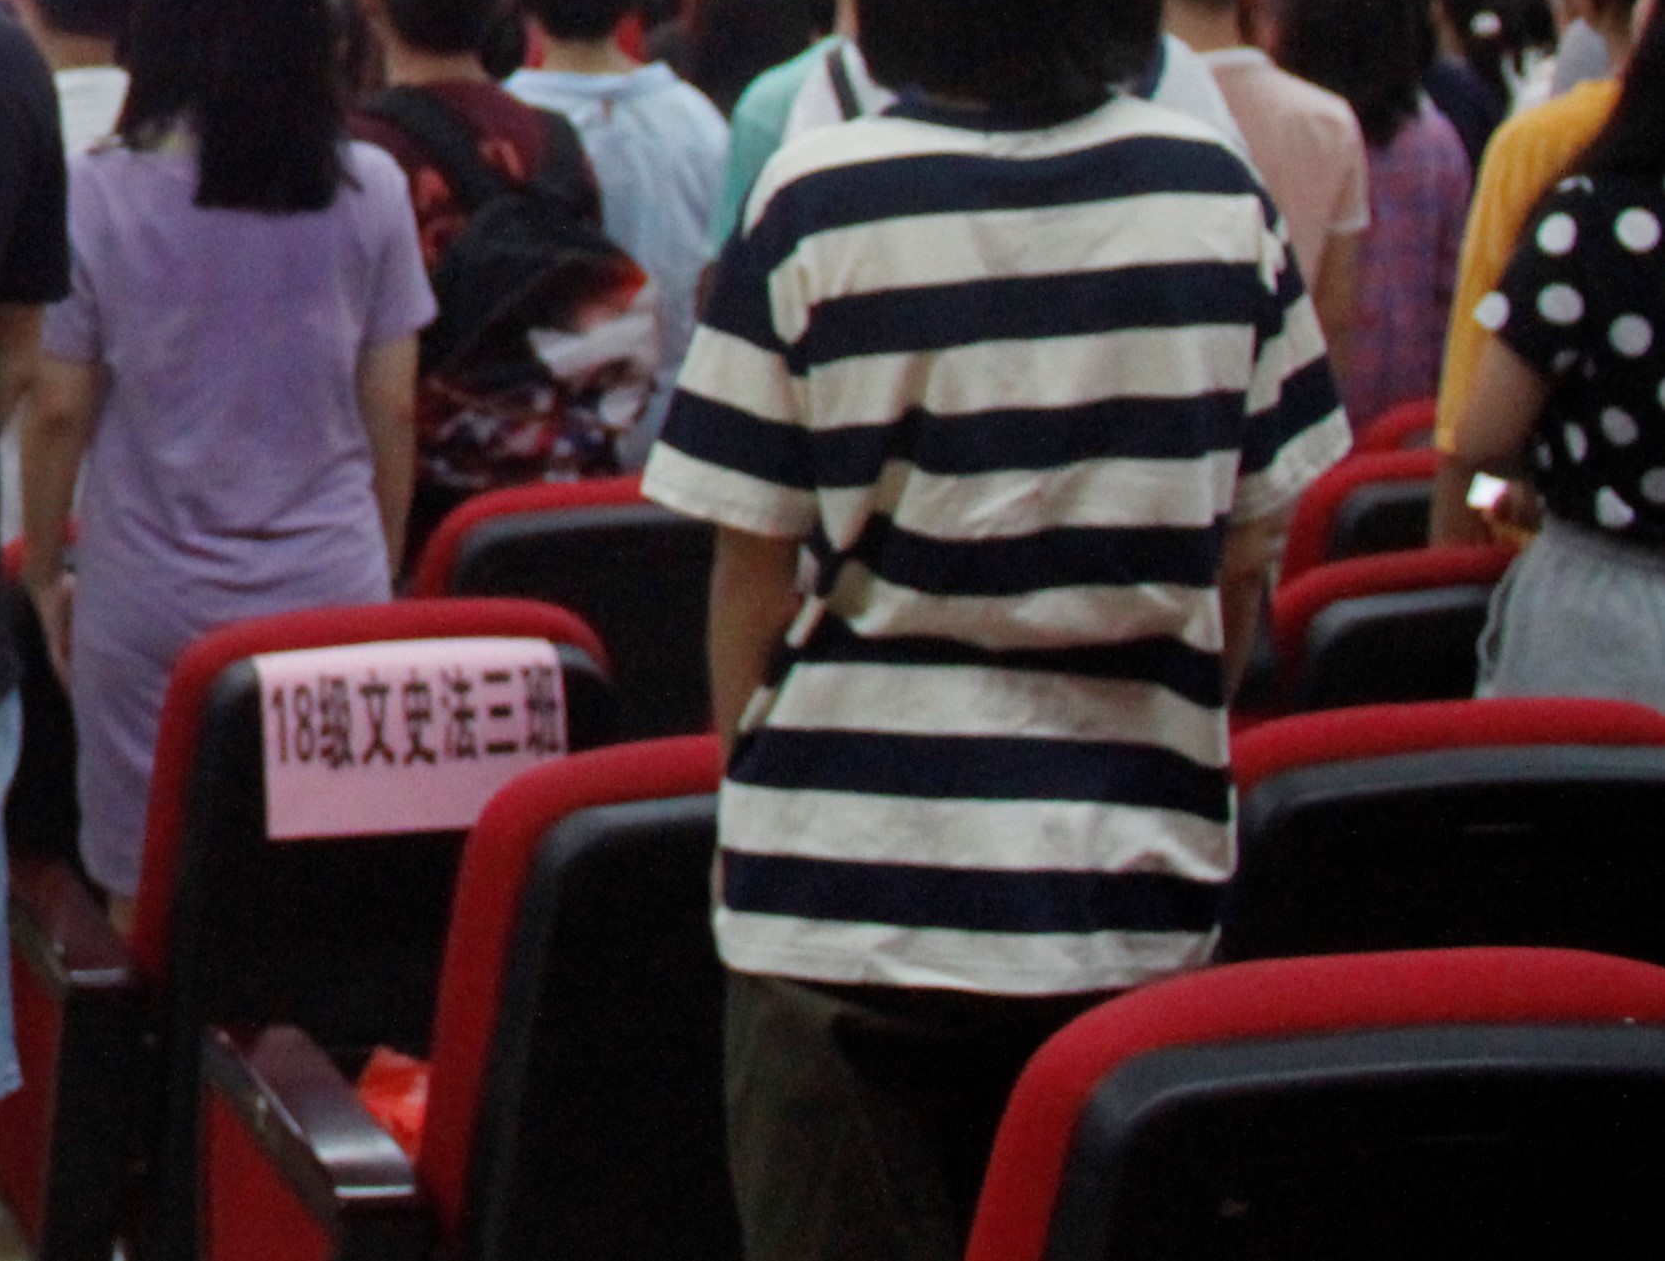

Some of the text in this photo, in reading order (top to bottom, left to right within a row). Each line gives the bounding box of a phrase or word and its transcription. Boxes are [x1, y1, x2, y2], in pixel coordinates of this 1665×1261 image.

[270, 662, 563, 769] 18级文史法三班
